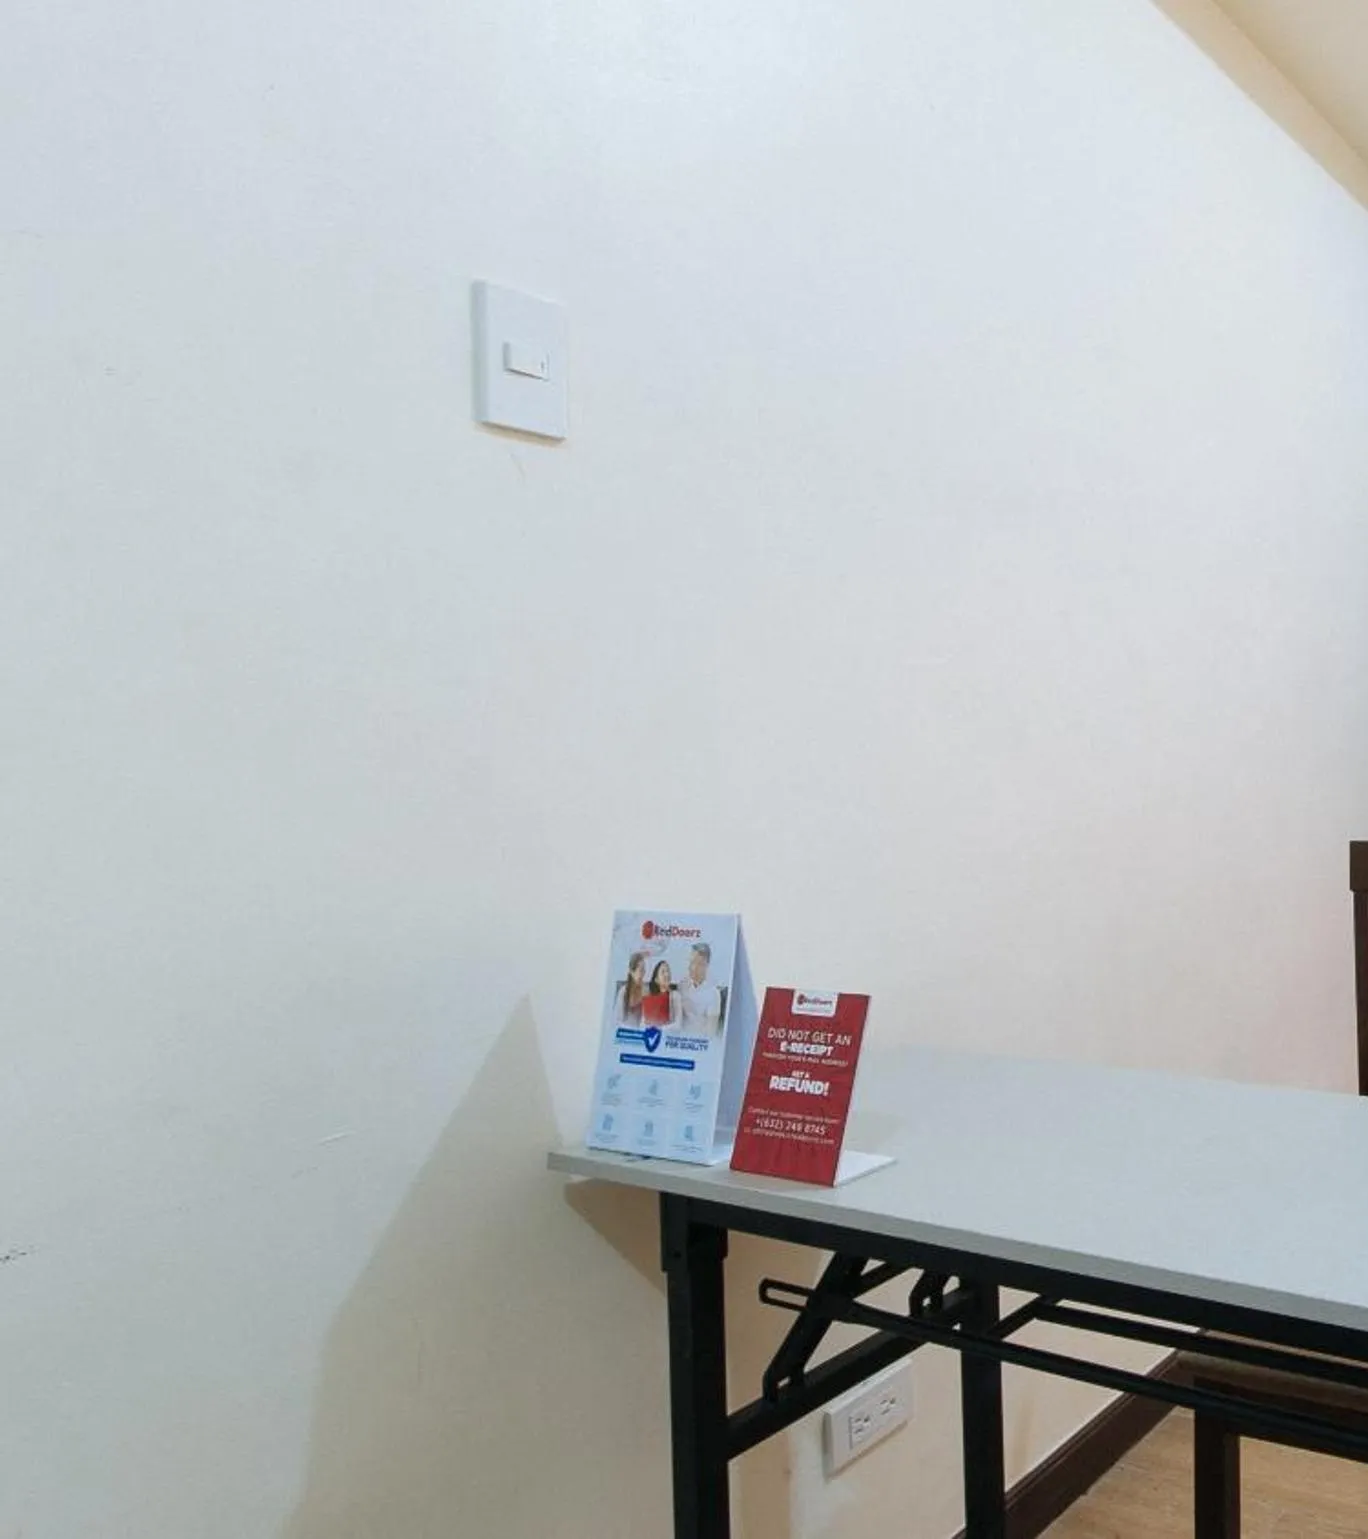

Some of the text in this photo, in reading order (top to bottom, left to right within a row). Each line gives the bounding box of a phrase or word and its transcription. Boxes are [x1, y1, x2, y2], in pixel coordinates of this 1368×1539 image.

[767, 1027, 853, 1046] DID NOT GET AN
[769, 1075, 830, 1096] REFUND!
